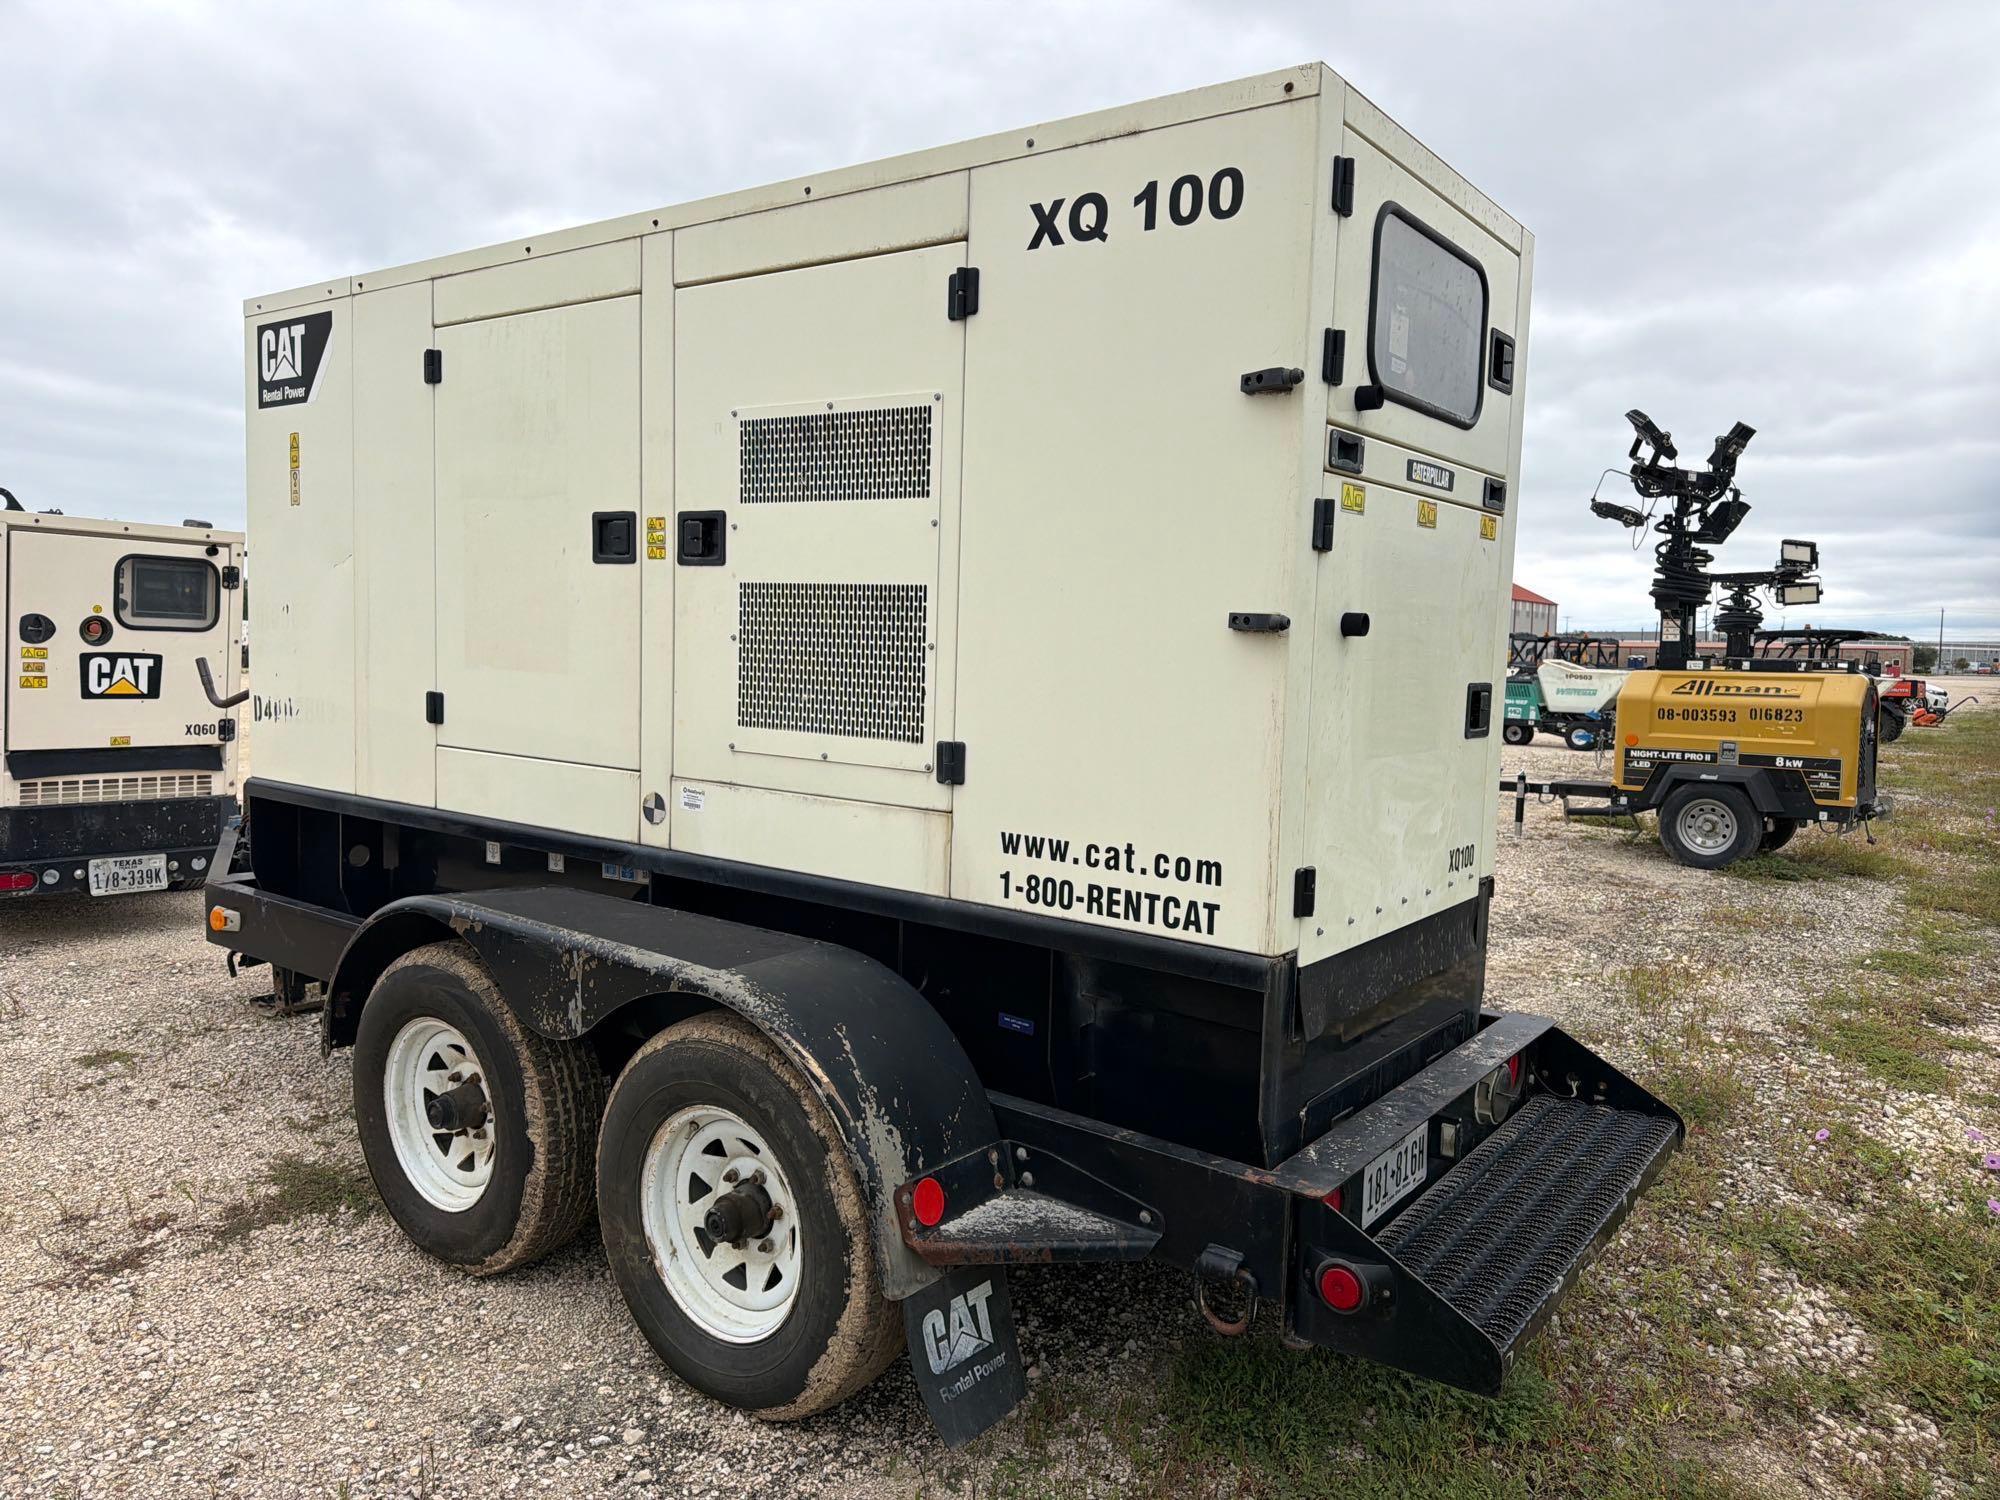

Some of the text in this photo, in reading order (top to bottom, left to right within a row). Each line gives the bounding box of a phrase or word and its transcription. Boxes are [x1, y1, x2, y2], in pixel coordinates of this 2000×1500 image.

[1026, 166, 1245, 252] XQ 100
[262, 324, 305, 382] CAT
[263, 386, 305, 403] Rental Power
[1412, 462, 1450, 489] CATERPILLAR
[88, 656, 154, 695] CAT
[1673, 679, 1782, 697] Allman
[1657, 707, 1803, 723] 08-003593 016823
[185, 723, 217, 737] XQ60
[1630, 749, 1682, 760] NIGHT-LITE
[1684, 752, 1704, 761] PRO
[1775, 756, 1804, 768] 8 kW
[113, 858, 143, 867] TEXAS
[1000, 831, 1223, 888] www.cat.com
[1448, 843, 1476, 874] XQ100
[999, 870, 1221, 936] 1-800-RENTCAT
[921, 1279, 995, 1376] CAT
[939, 1350, 1007, 1404] Rental Power
